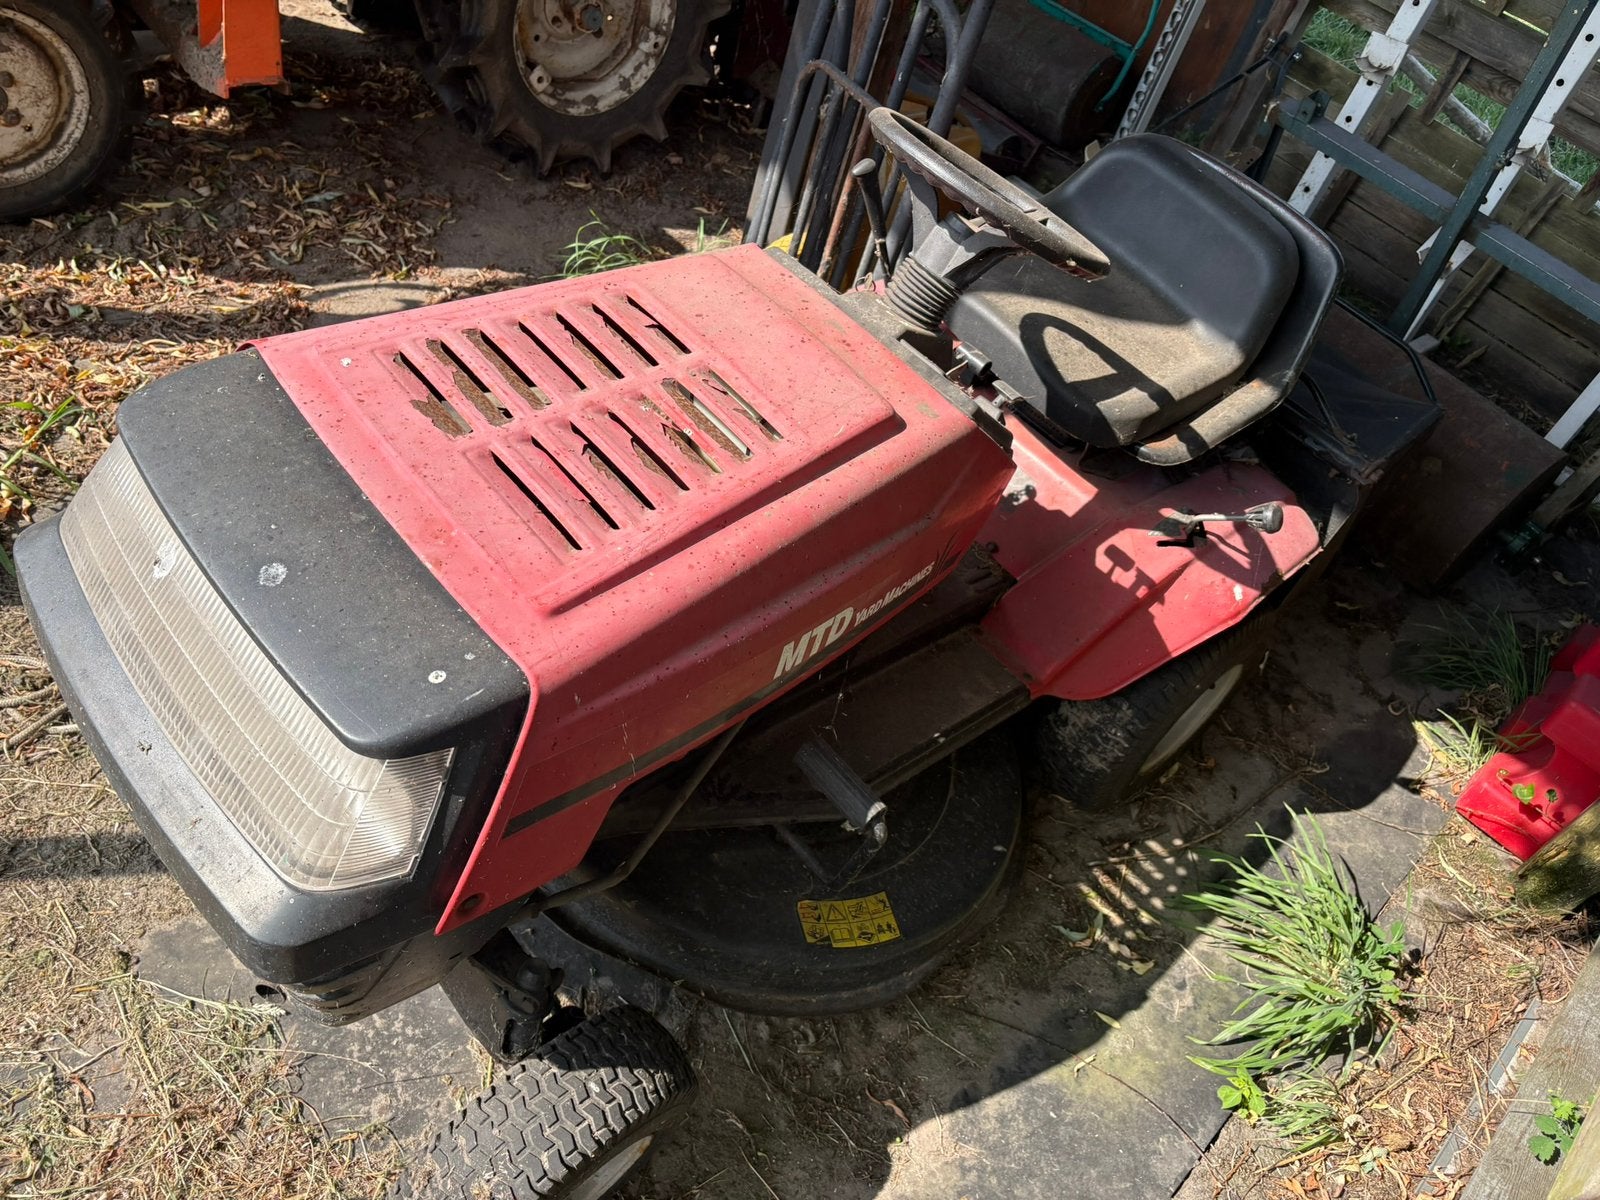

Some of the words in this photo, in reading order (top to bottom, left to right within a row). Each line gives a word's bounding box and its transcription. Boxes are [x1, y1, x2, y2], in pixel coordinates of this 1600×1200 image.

[773, 606, 854, 680] MTD
[854, 599, 883, 627] YARD
[881, 561, 935, 608] MACHINES
